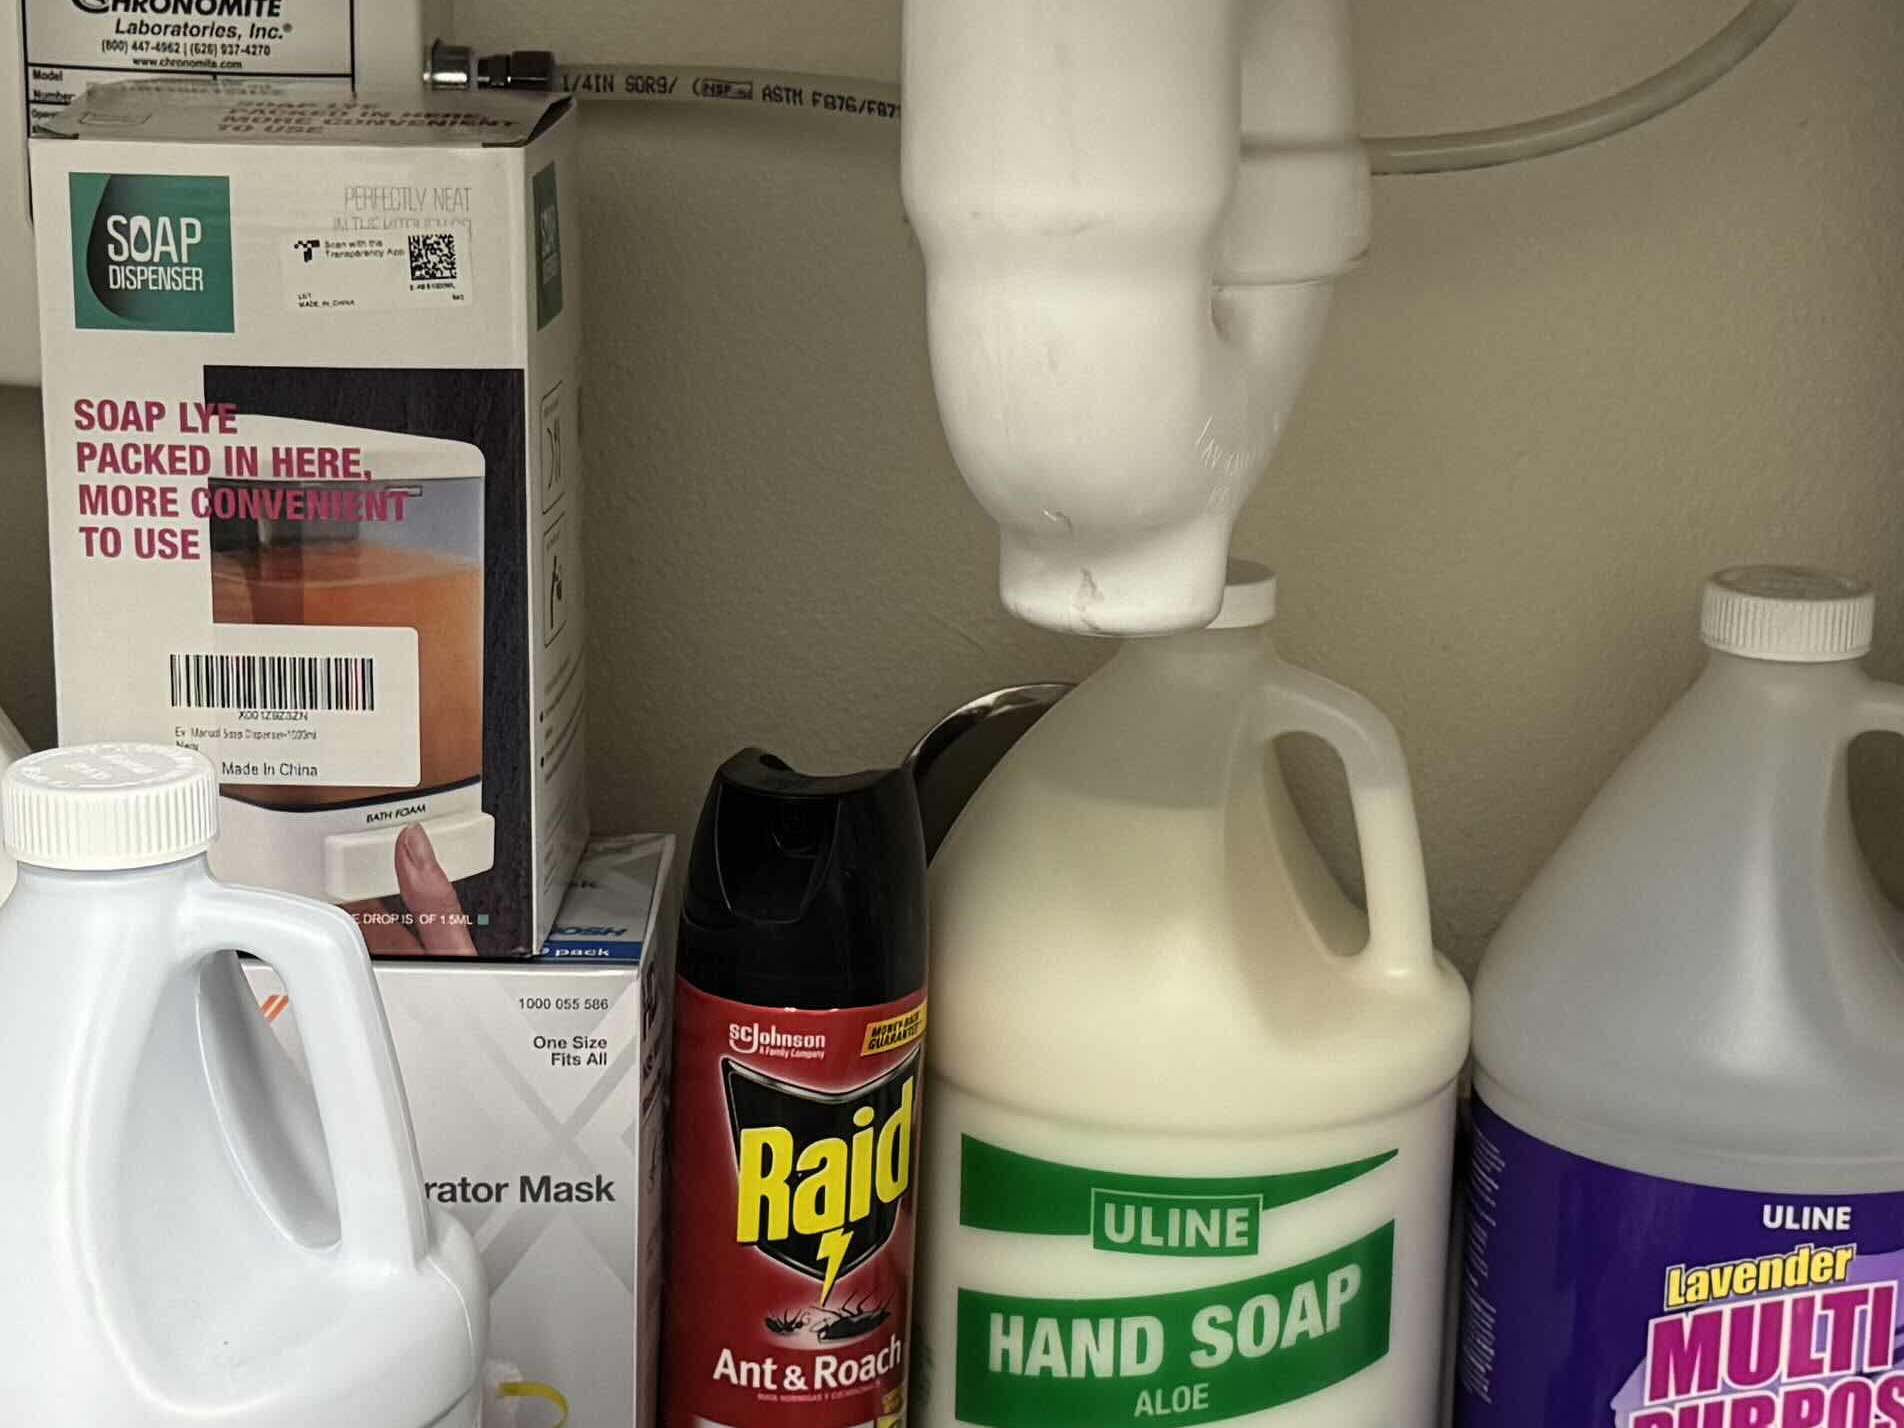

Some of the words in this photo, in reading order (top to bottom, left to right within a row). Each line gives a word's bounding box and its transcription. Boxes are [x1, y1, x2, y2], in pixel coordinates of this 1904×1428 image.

[115, 18, 242, 39] Laboratories,
[106, 215, 201, 264] SOAP
[109, 266, 204, 292] DISPENSER
[74, 399, 166, 433] SOAP
[179, 402, 237, 436] LYE
[76, 443, 211, 476] PACKED
[224, 446, 258, 477] IN
[272, 447, 372, 481] HERE,
[78, 484, 179, 518] MORE
[191, 487, 409, 522] CONVENIENT
[79, 527, 121, 558] TO
[134, 528, 200, 560] USE
[222, 762, 259, 776] Made
[281, 763, 318, 777] China
[395, 803, 426, 820] FOAM
[519, 998, 551, 1010] 1000
[556, 998, 581, 1010] 055
[584, 998, 608, 1010] 586
[533, 1036, 567, 1051] One
[571, 1036, 607, 1051] Size
[551, 1052, 581, 1066] Fits
[586, 1052, 608, 1066] All
[737, 1076, 913, 1243] Raid
[519, 1175, 615, 1204] Mask
[1104, 1203, 1250, 1248] ULINE
[1762, 1205, 1851, 1231] ULINE
[1664, 1243, 1856, 1309] Lavender
[988, 1311, 1164, 1379] HAND
[1190, 1263, 1362, 1369] SOAP
[1645, 1280, 1898, 1406] MULTI
[712, 1348, 777, 1390] Ant
[783, 1365, 808, 1391] &
[814, 1334, 902, 1390] Roach
[1133, 1383, 1209, 1417] ALOE
